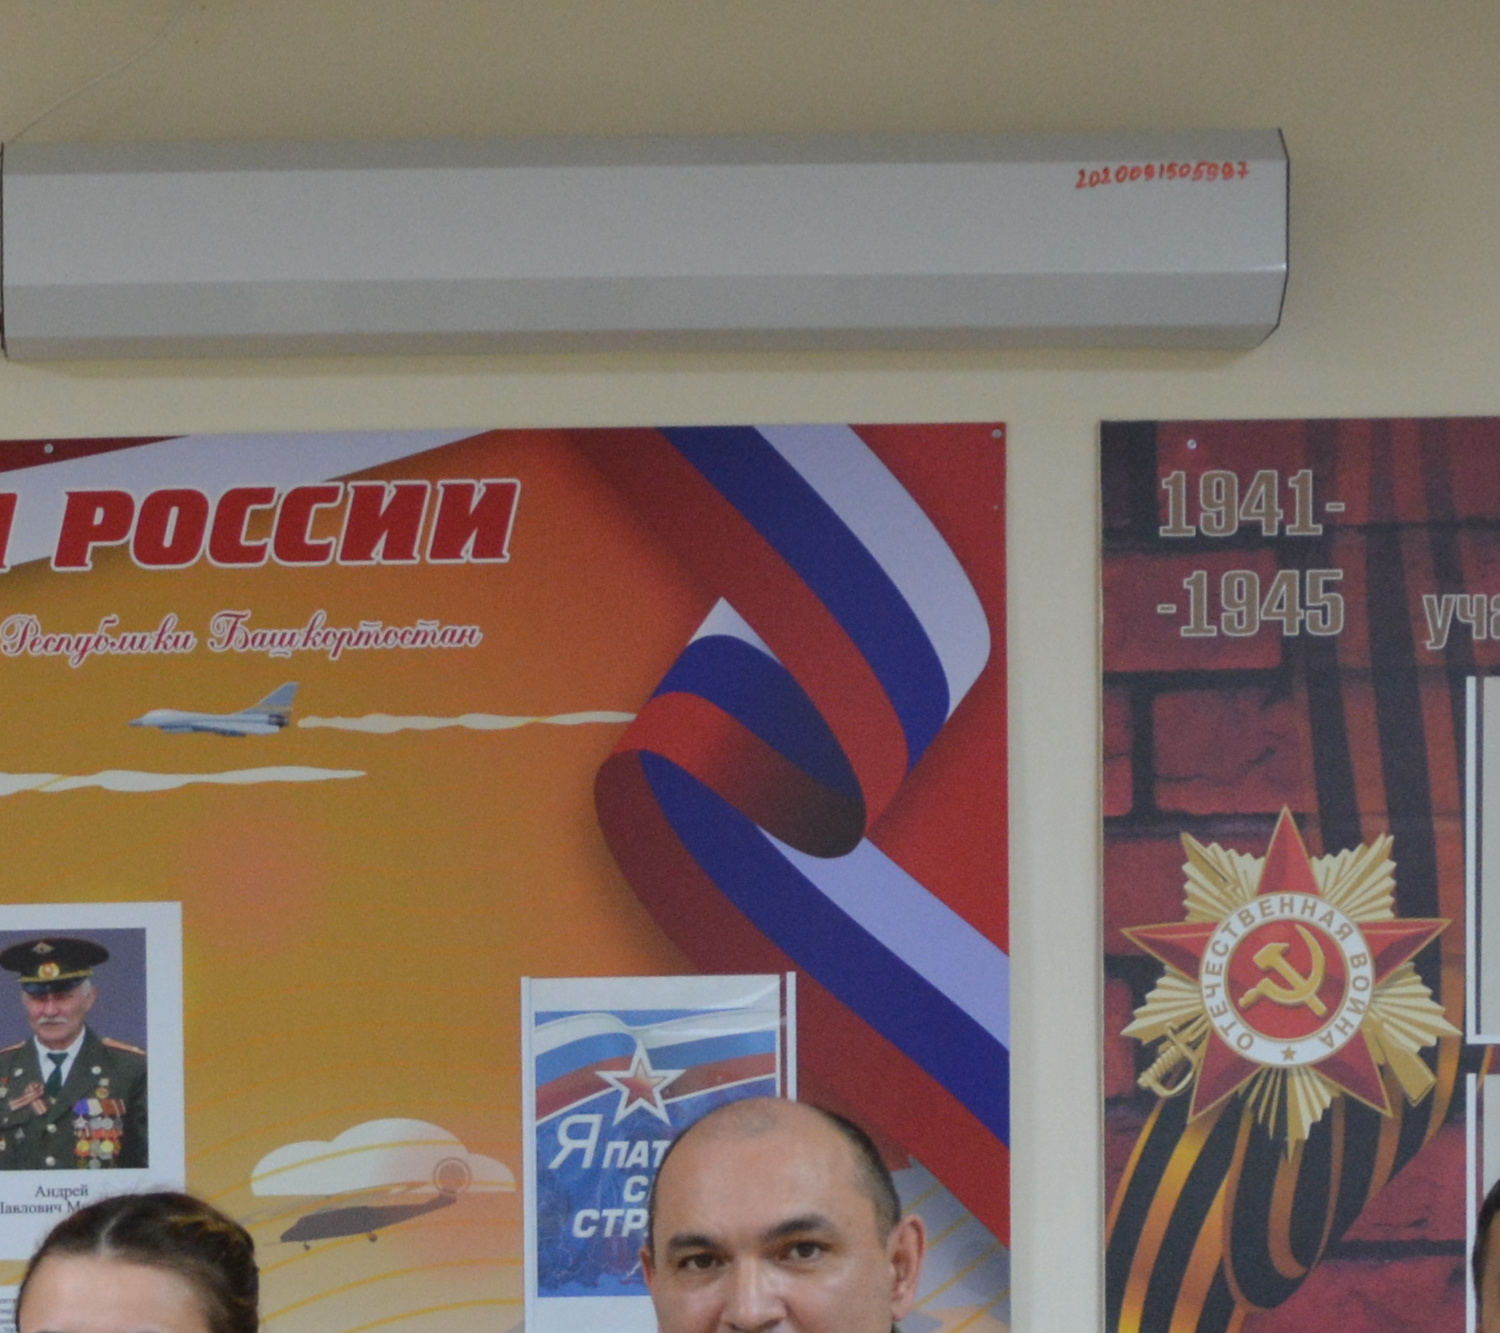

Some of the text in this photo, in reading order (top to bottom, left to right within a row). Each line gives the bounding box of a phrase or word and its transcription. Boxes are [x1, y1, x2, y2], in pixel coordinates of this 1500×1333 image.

[50, 477, 522, 573] РОССИИ
[1157, 467, 1346, 539] 1941-
[1, 613, 197, 668] Республики
[206, 608, 483, 662] Башкортостан
[1157, 568, 1346, 639] -1945
[1203, 895, 1355, 1050] ОТЕЧЕСТВЕННАЯ
[548, 1113, 604, 1170] Я
[33, 1182, 89, 1200] Андрей
